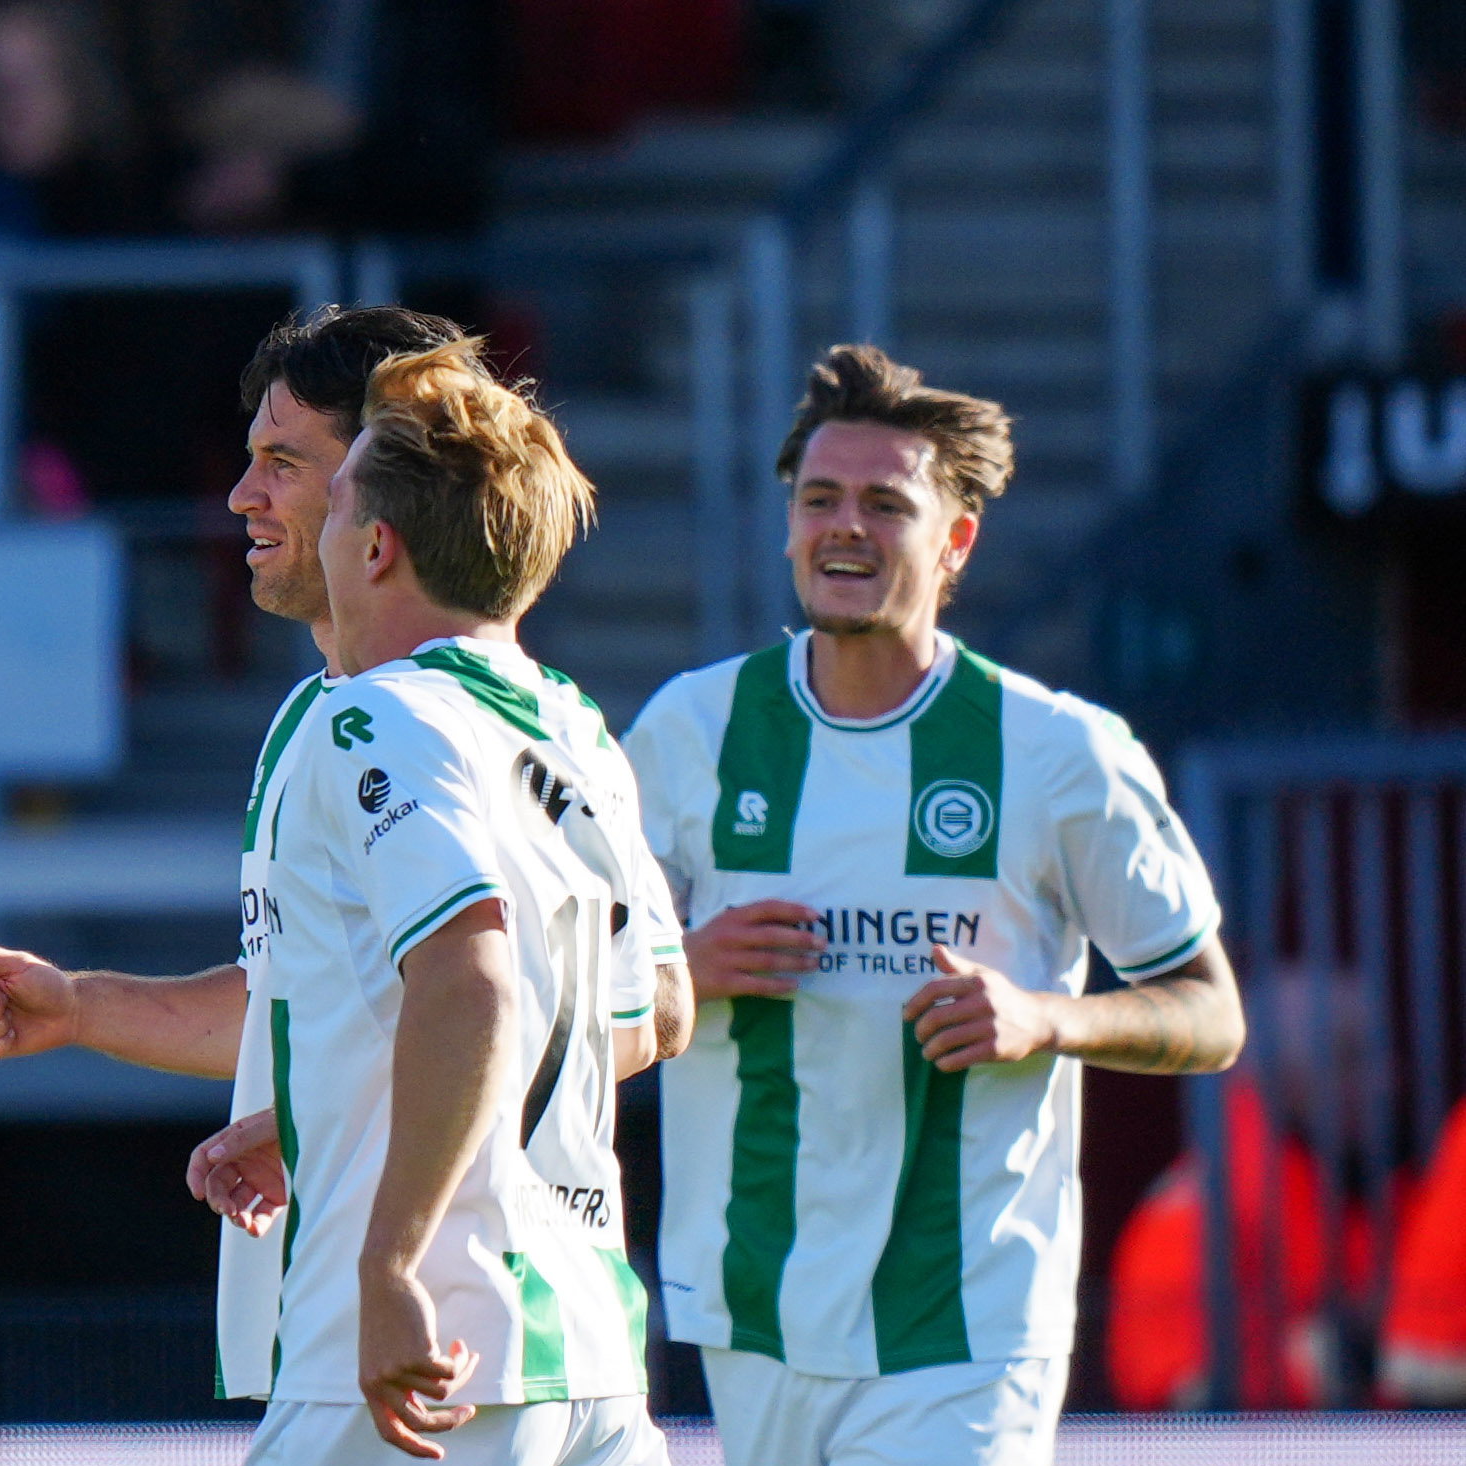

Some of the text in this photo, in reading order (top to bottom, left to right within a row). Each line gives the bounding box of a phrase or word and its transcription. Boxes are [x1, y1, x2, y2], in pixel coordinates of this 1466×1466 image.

[804, 907, 981, 948] NINGEN
[818, 953, 936, 975] OF TALEN
